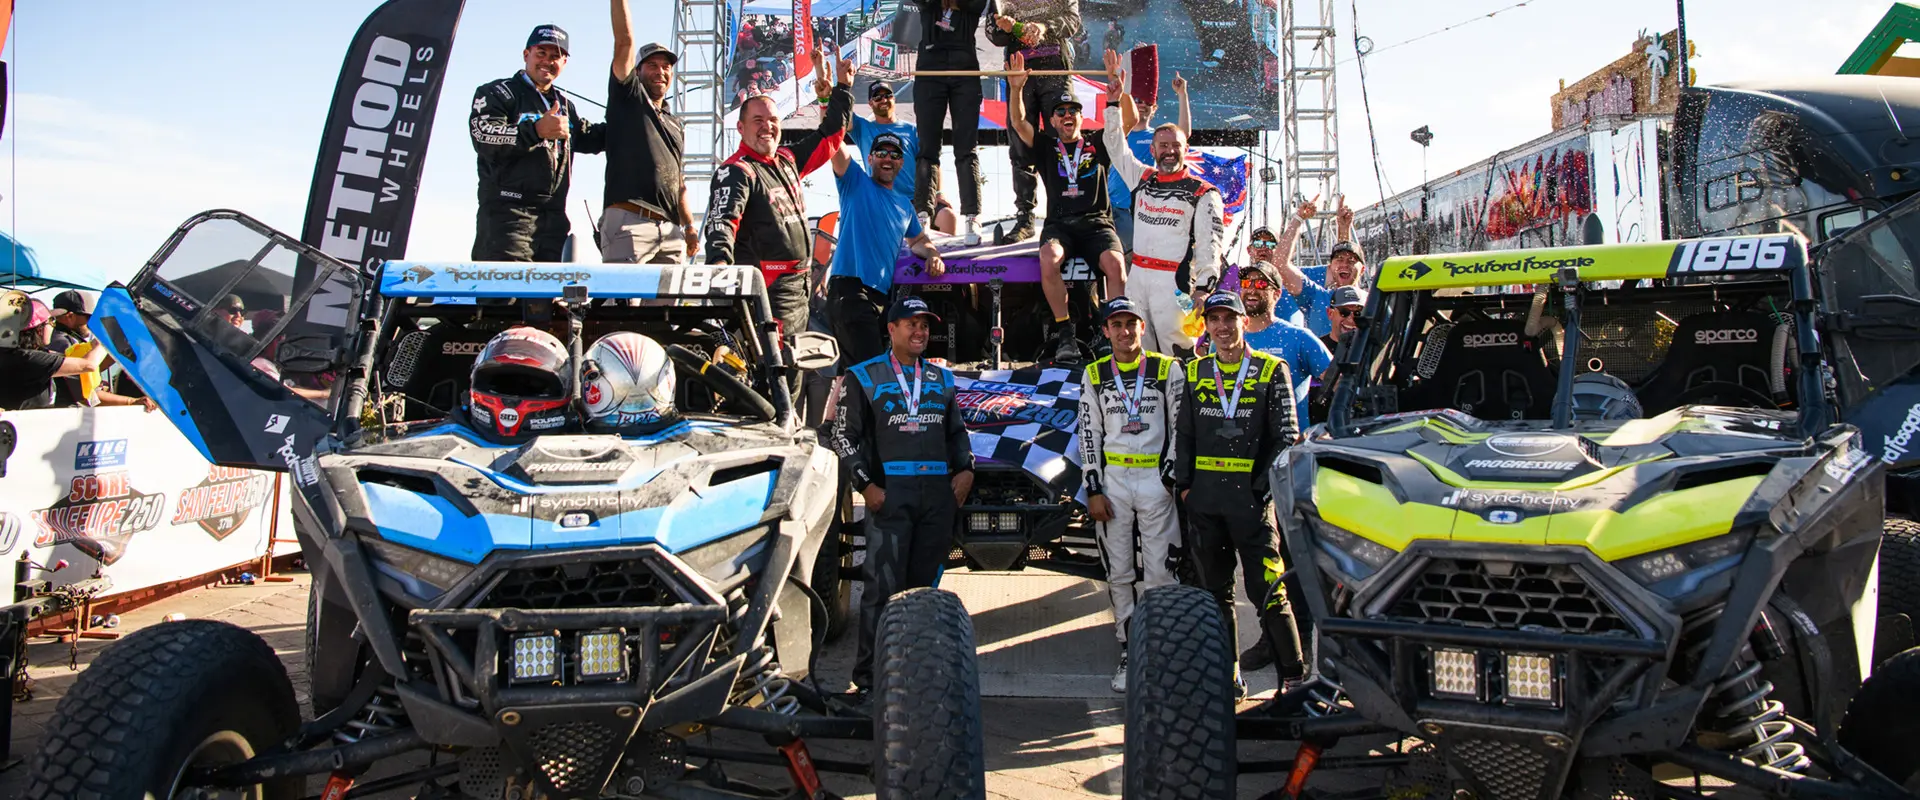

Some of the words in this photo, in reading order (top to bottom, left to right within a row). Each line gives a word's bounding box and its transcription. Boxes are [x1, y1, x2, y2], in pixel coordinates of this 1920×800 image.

[379, 46, 434, 203] WHEELS
[306, 35, 412, 328] METHOD
[1676, 237, 1791, 273] 1896
[445, 266, 523, 285] Rockford
[1443, 259, 1523, 278] Rockford
[668, 265, 755, 296] 1841
[1463, 332, 1519, 349] sparco
[1694, 328, 1758, 345] sparco
[442, 340, 486, 355] sparc
[78, 441, 127, 457] KING
[525, 461, 632, 473] PROGRESSIVE
[1465, 459, 1580, 471] PROGRESSIVE
[70, 472, 130, 502] SCORE
[173, 487, 207, 523] SAN
[205, 480, 248, 517] FELIPE
[539, 495, 643, 510] synchrony
[1470, 493, 1581, 509] synchrony
[66, 499, 128, 540] FELIPE
[120, 492, 166, 534] 250
